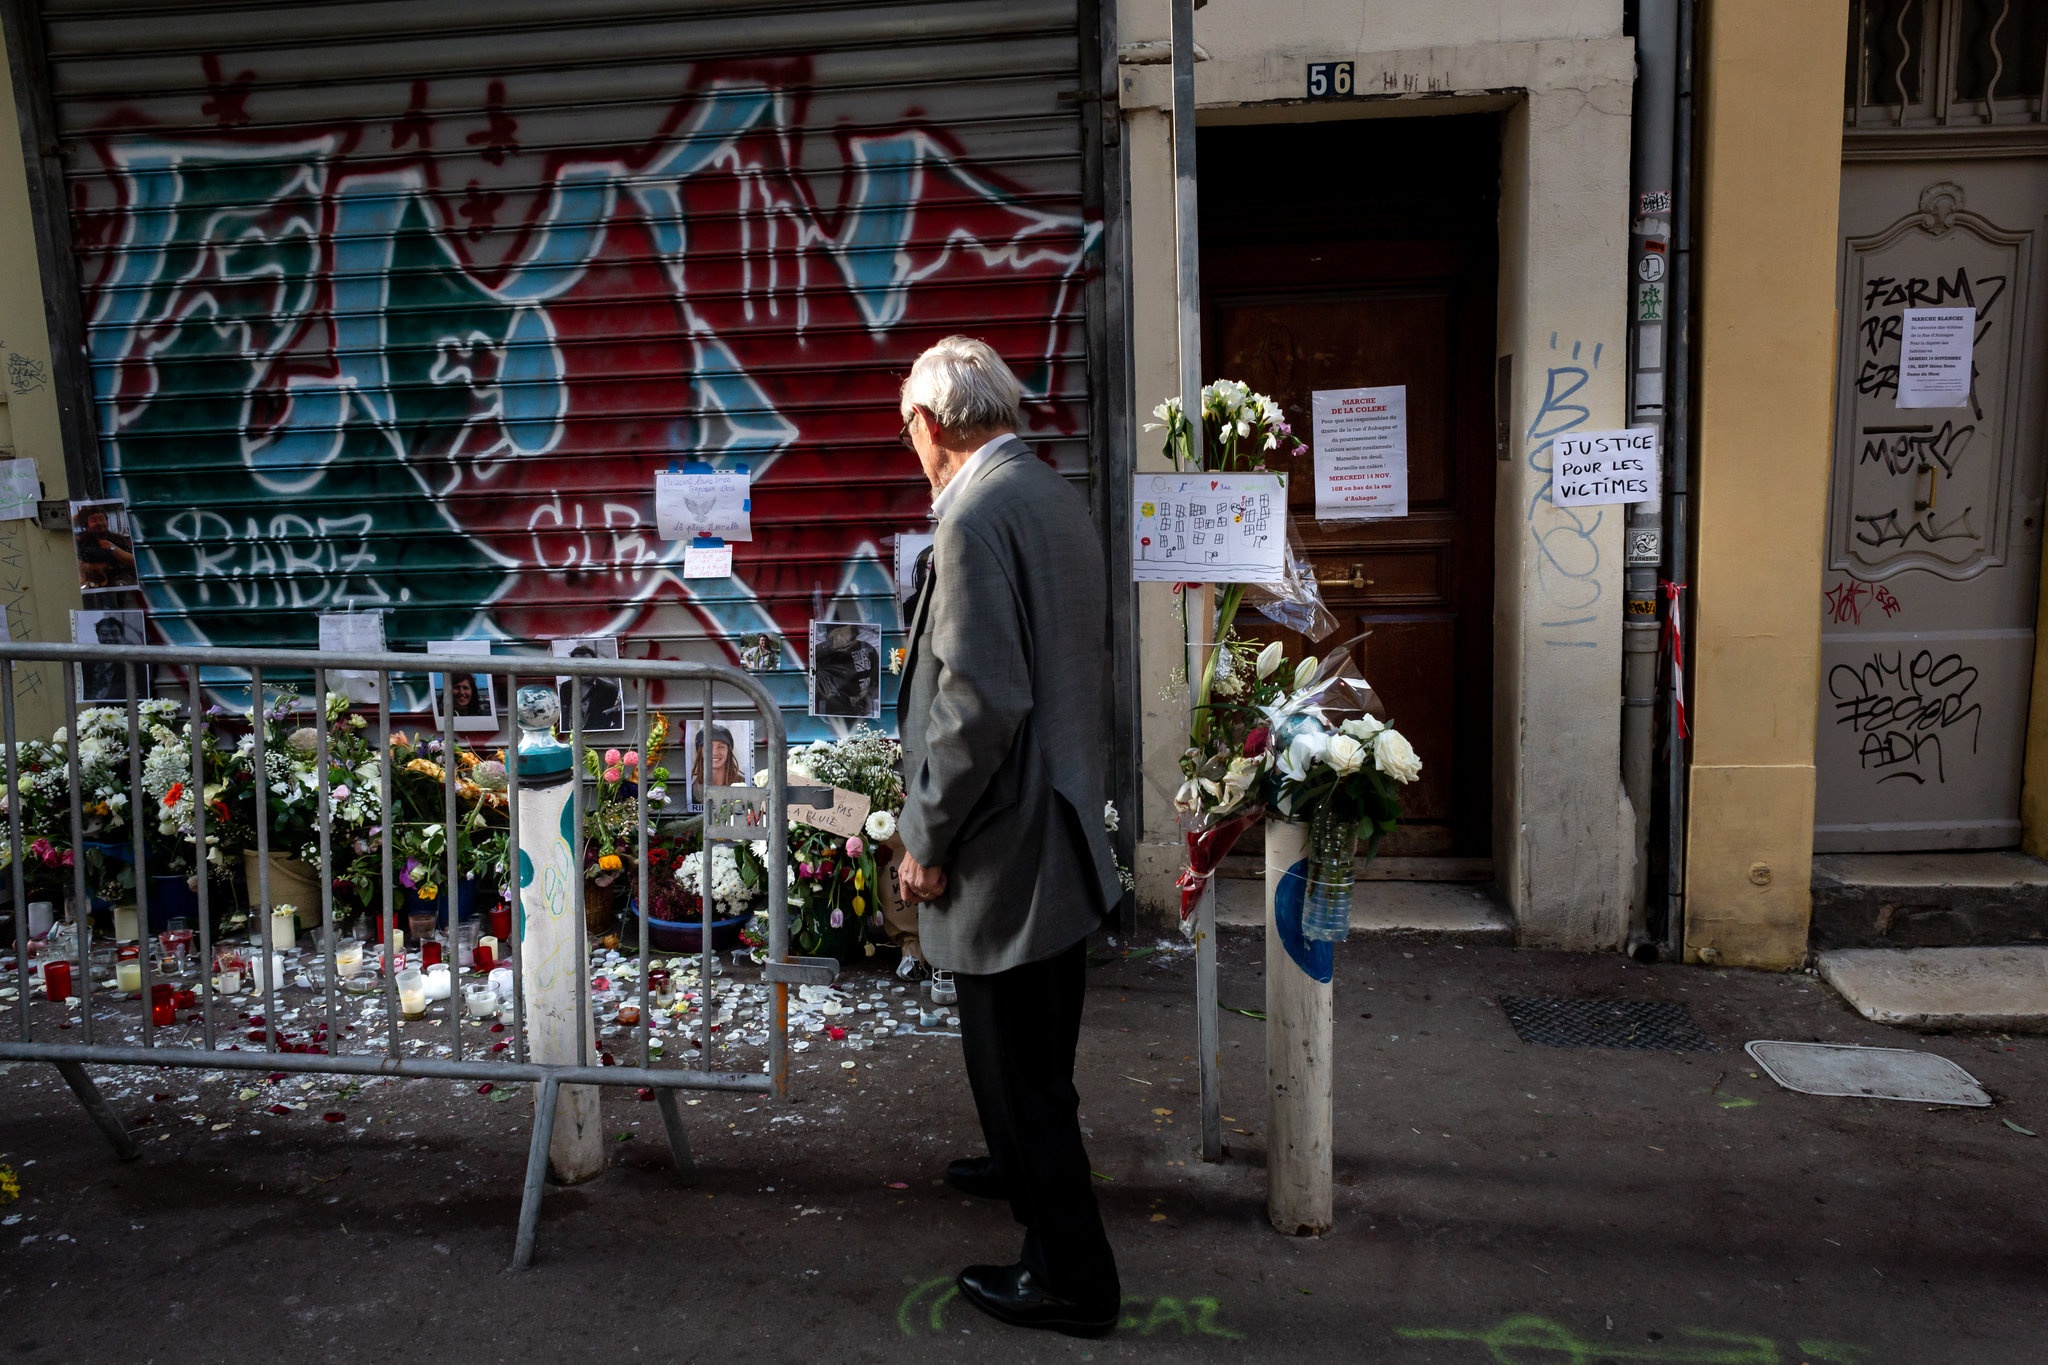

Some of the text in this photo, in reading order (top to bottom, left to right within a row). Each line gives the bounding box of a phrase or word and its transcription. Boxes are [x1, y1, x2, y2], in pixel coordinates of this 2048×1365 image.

[1310, 63, 1351, 96] 56
[1341, 397, 1377, 406] MARCHE
[1331, 407, 1342, 415] DE
[1355, 405, 1387, 414] COLERE
[1354, 415, 1388, 424] responsables
[1560, 433, 1654, 457] JUSTICE
[1562, 459, 1644, 477] POUR LES
[1328, 474, 1365, 482] MERCREDI
[1560, 477, 1648, 498] VICTIMES
[1344, 494, 1378, 502] d'Aubagne
